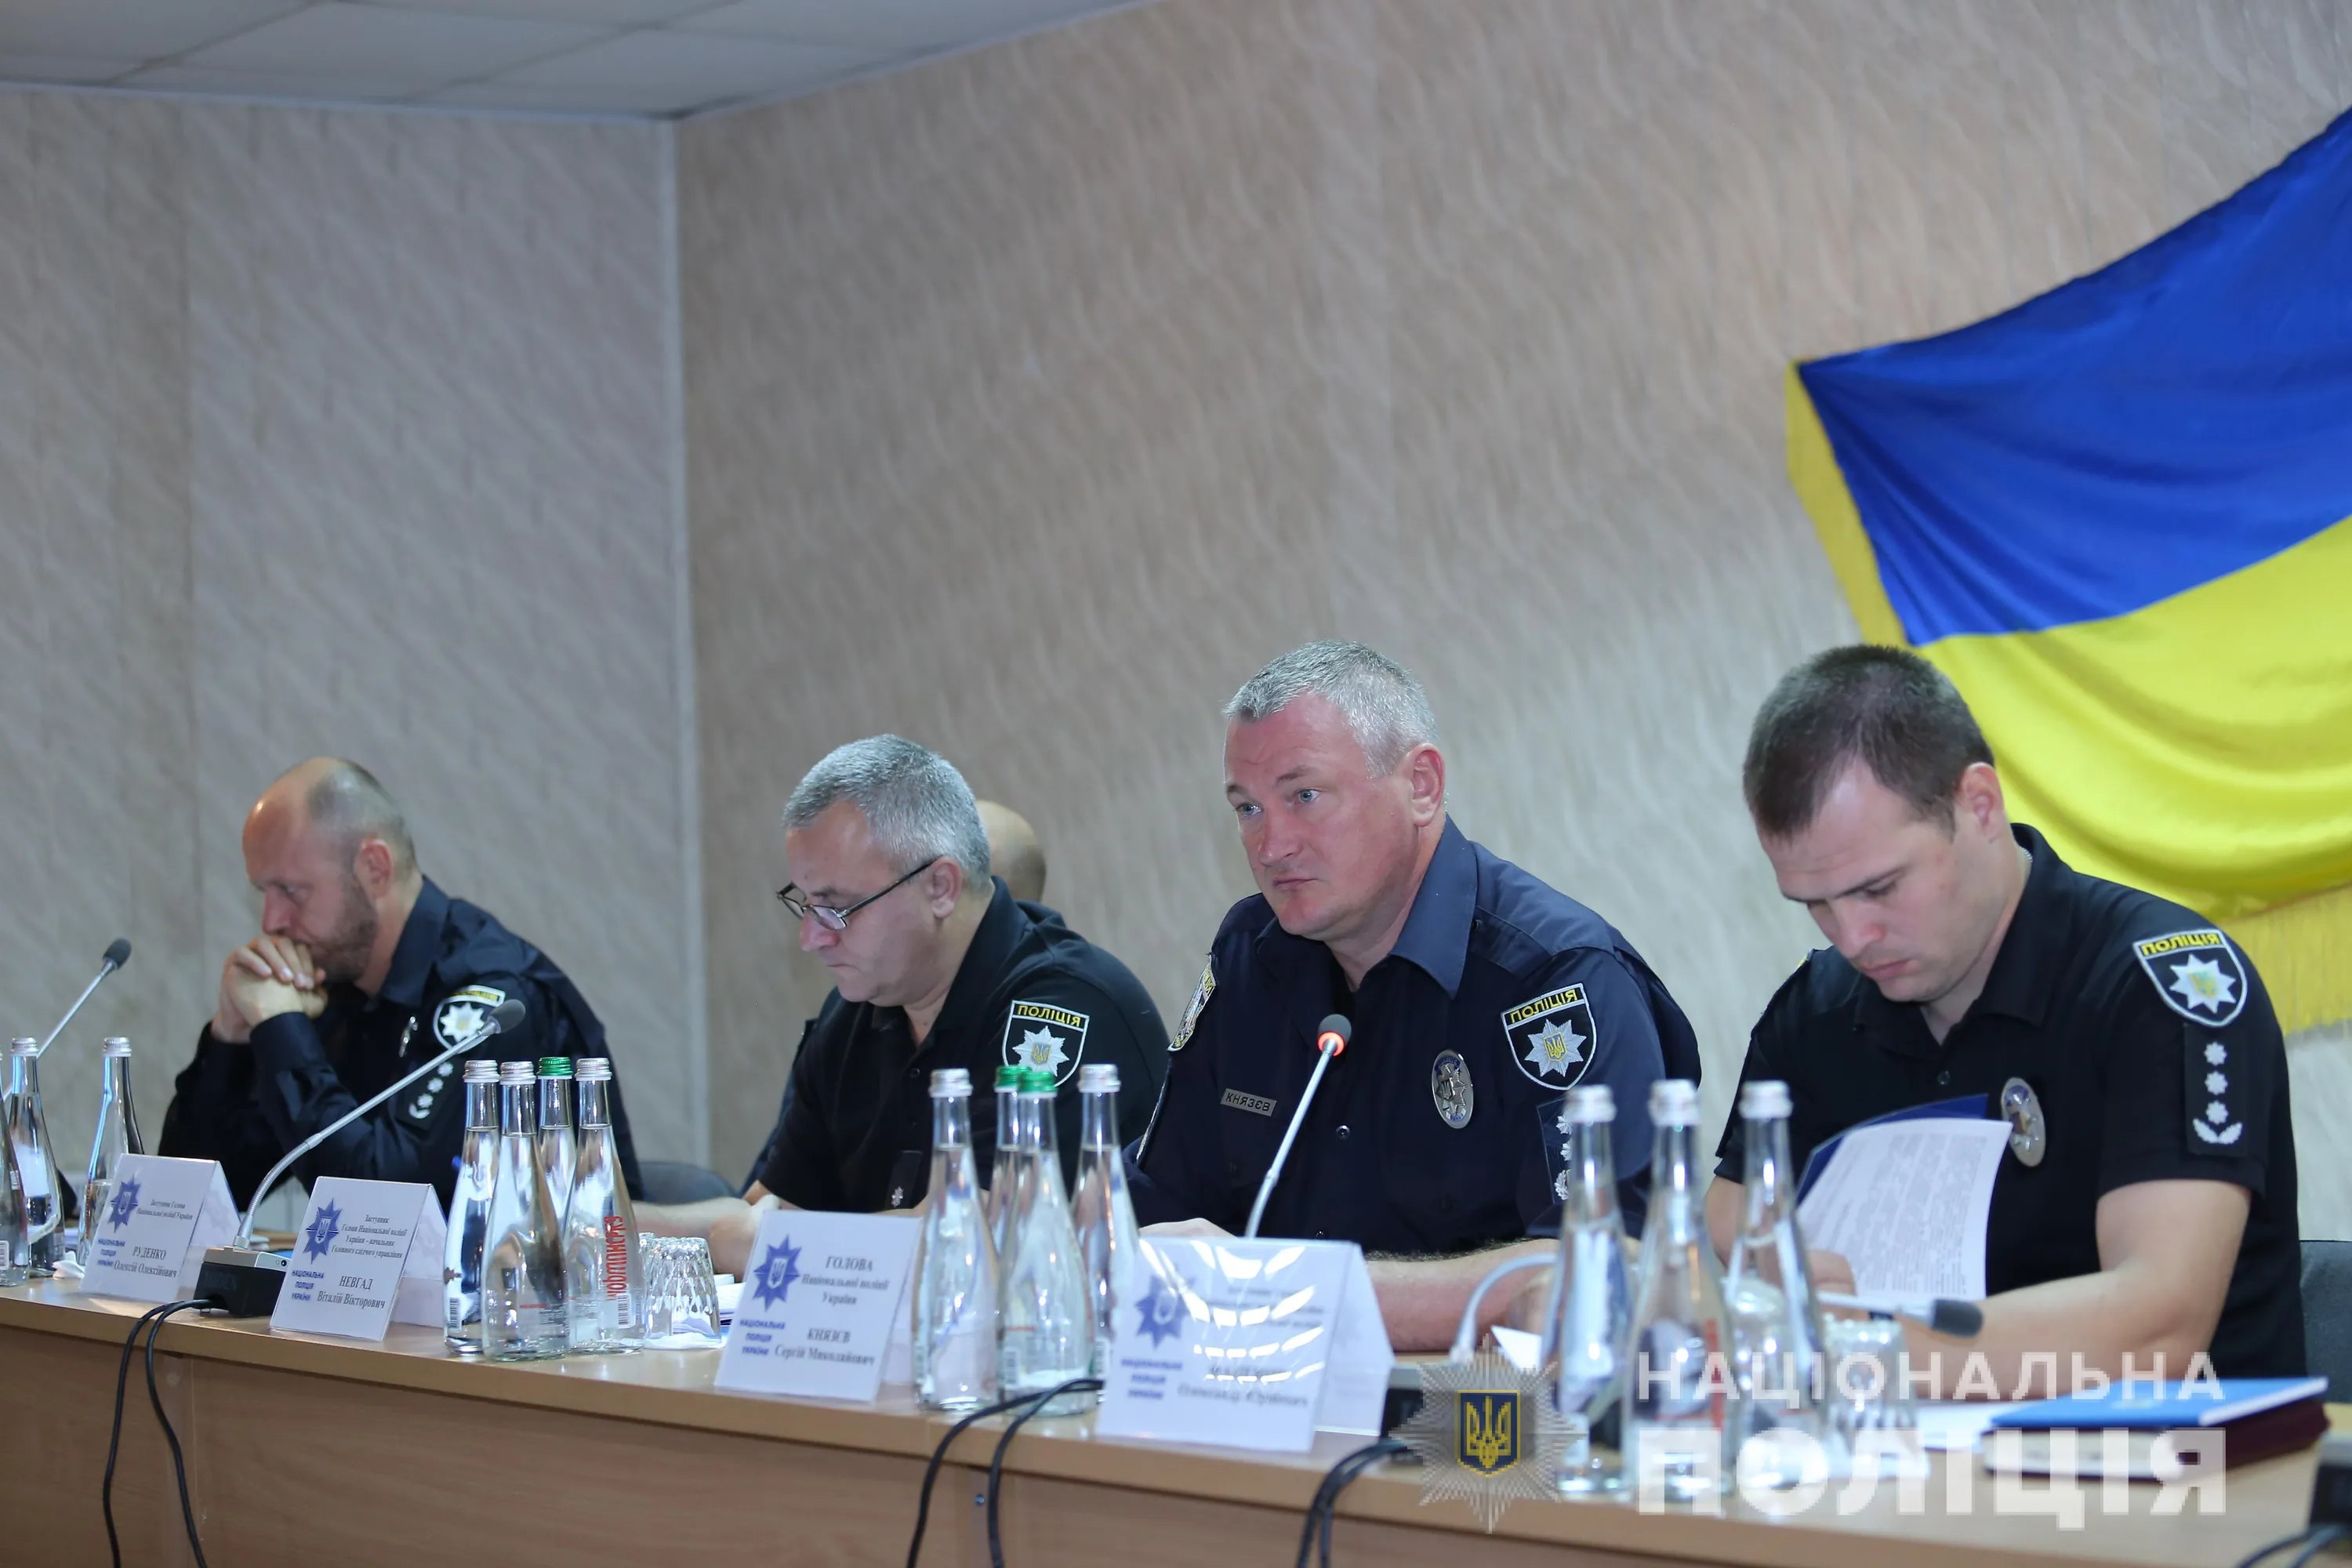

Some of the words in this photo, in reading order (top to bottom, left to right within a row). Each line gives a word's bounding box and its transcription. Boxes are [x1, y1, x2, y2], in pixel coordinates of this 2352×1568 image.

[2141, 933, 2221, 956] ПОЛІЦІЯ
[1509, 989, 1578, 1024] ПОЛІЦІЯ
[1018, 1005, 1081, 1027] ПОЛІЦІЯ
[1225, 1092, 1271, 1112] КНЯЗЄВ
[132, 1247, 166, 1260] РУДЕНКО
[825, 1255, 873, 1272] ГОЛОВА
[339, 1276, 373, 1290] НЕВГАД
[317, 1290, 343, 1304] Віталій
[343, 1293, 386, 1309] Вікторович
[807, 1328, 851, 1345] КНЯЗЄВ
[775, 1345, 806, 1361] Сергій
